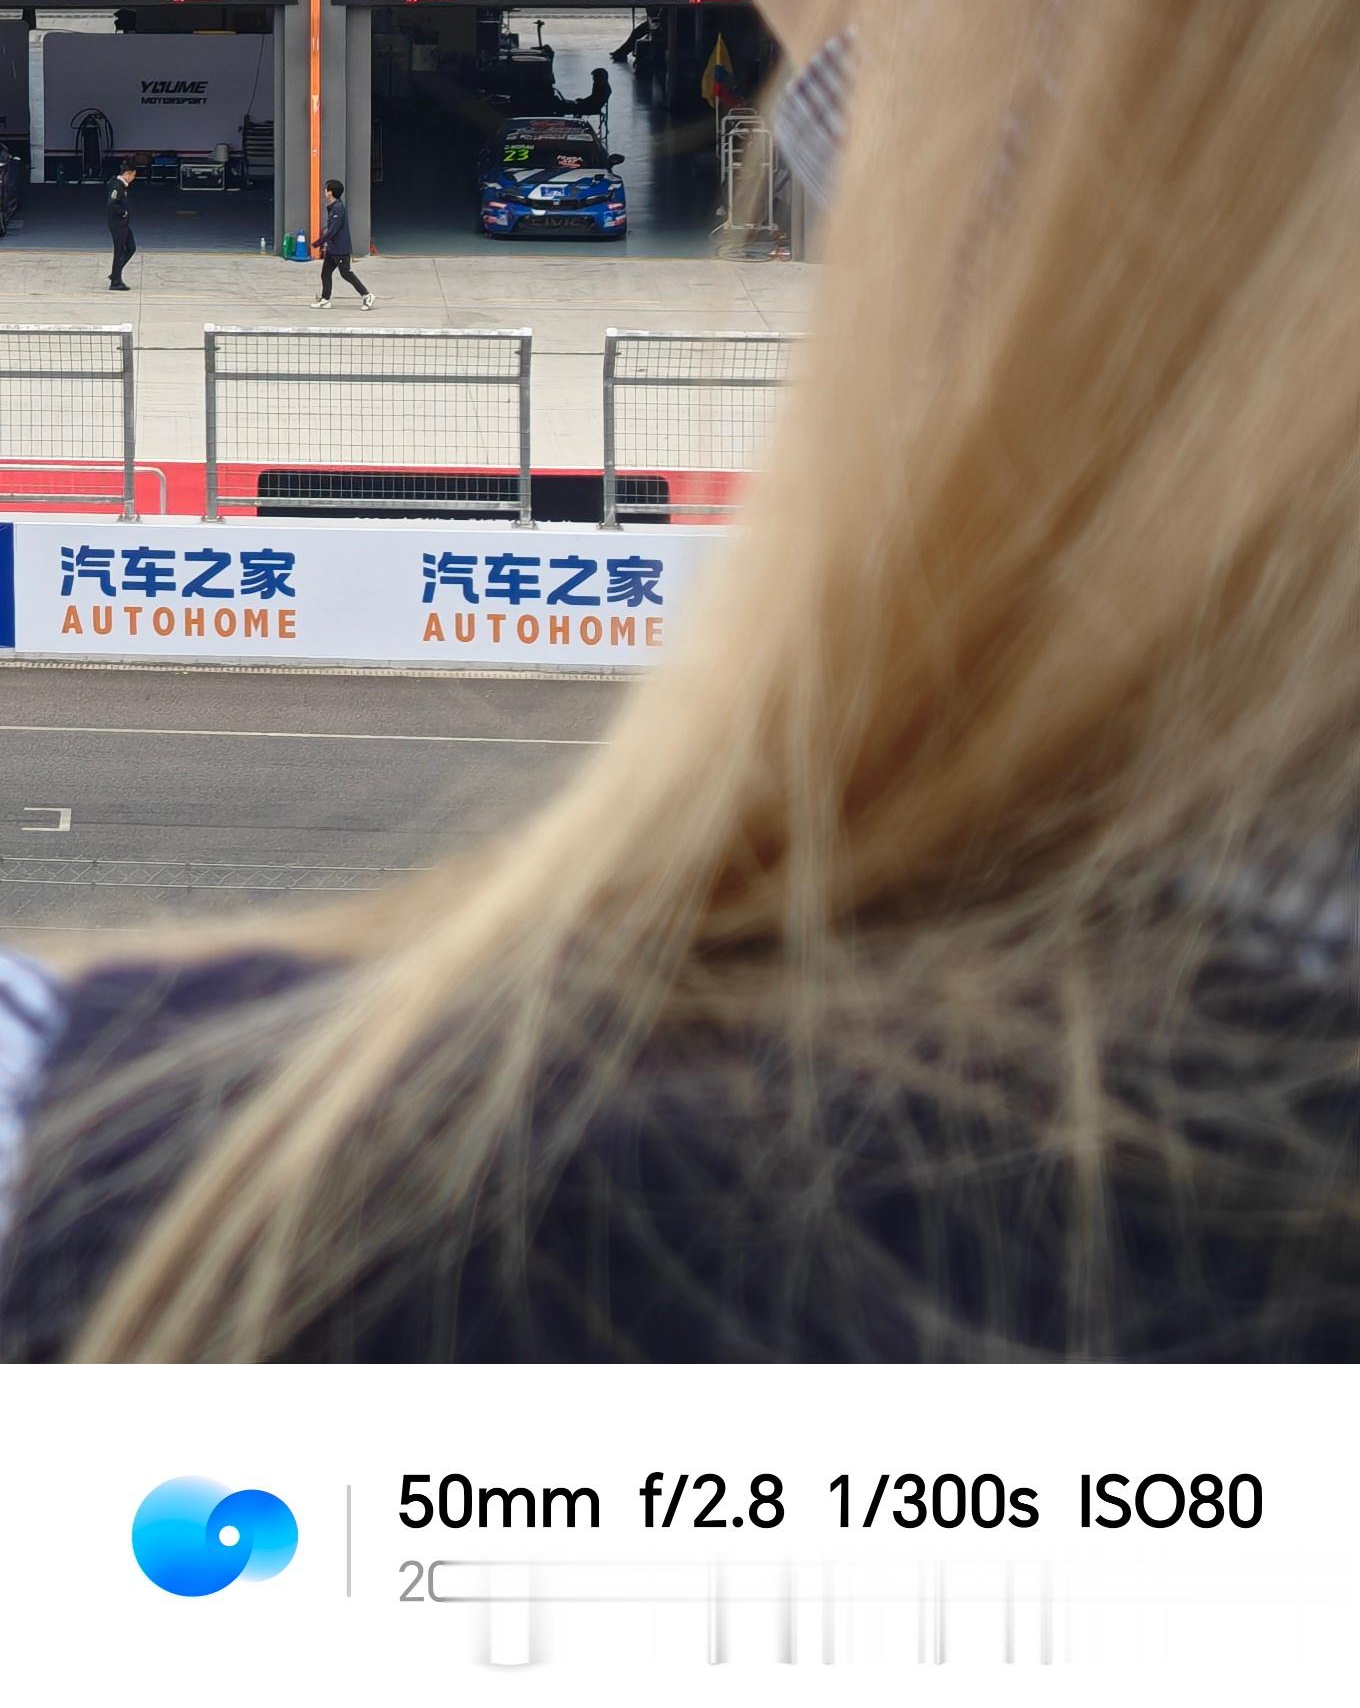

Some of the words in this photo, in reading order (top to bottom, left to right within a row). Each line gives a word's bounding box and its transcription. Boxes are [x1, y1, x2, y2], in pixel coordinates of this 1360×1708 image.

[140, 80, 209, 94] YOUME
[140, 96, 209, 105] MOTORSPORT
[503, 149, 529, 162] 23
[60, 545, 297, 601] 汽车之家
[421, 550, 665, 609] 汽车之家
[61, 605, 298, 639] AUTOHOME
[422, 612, 665, 648] AUTOHOME
